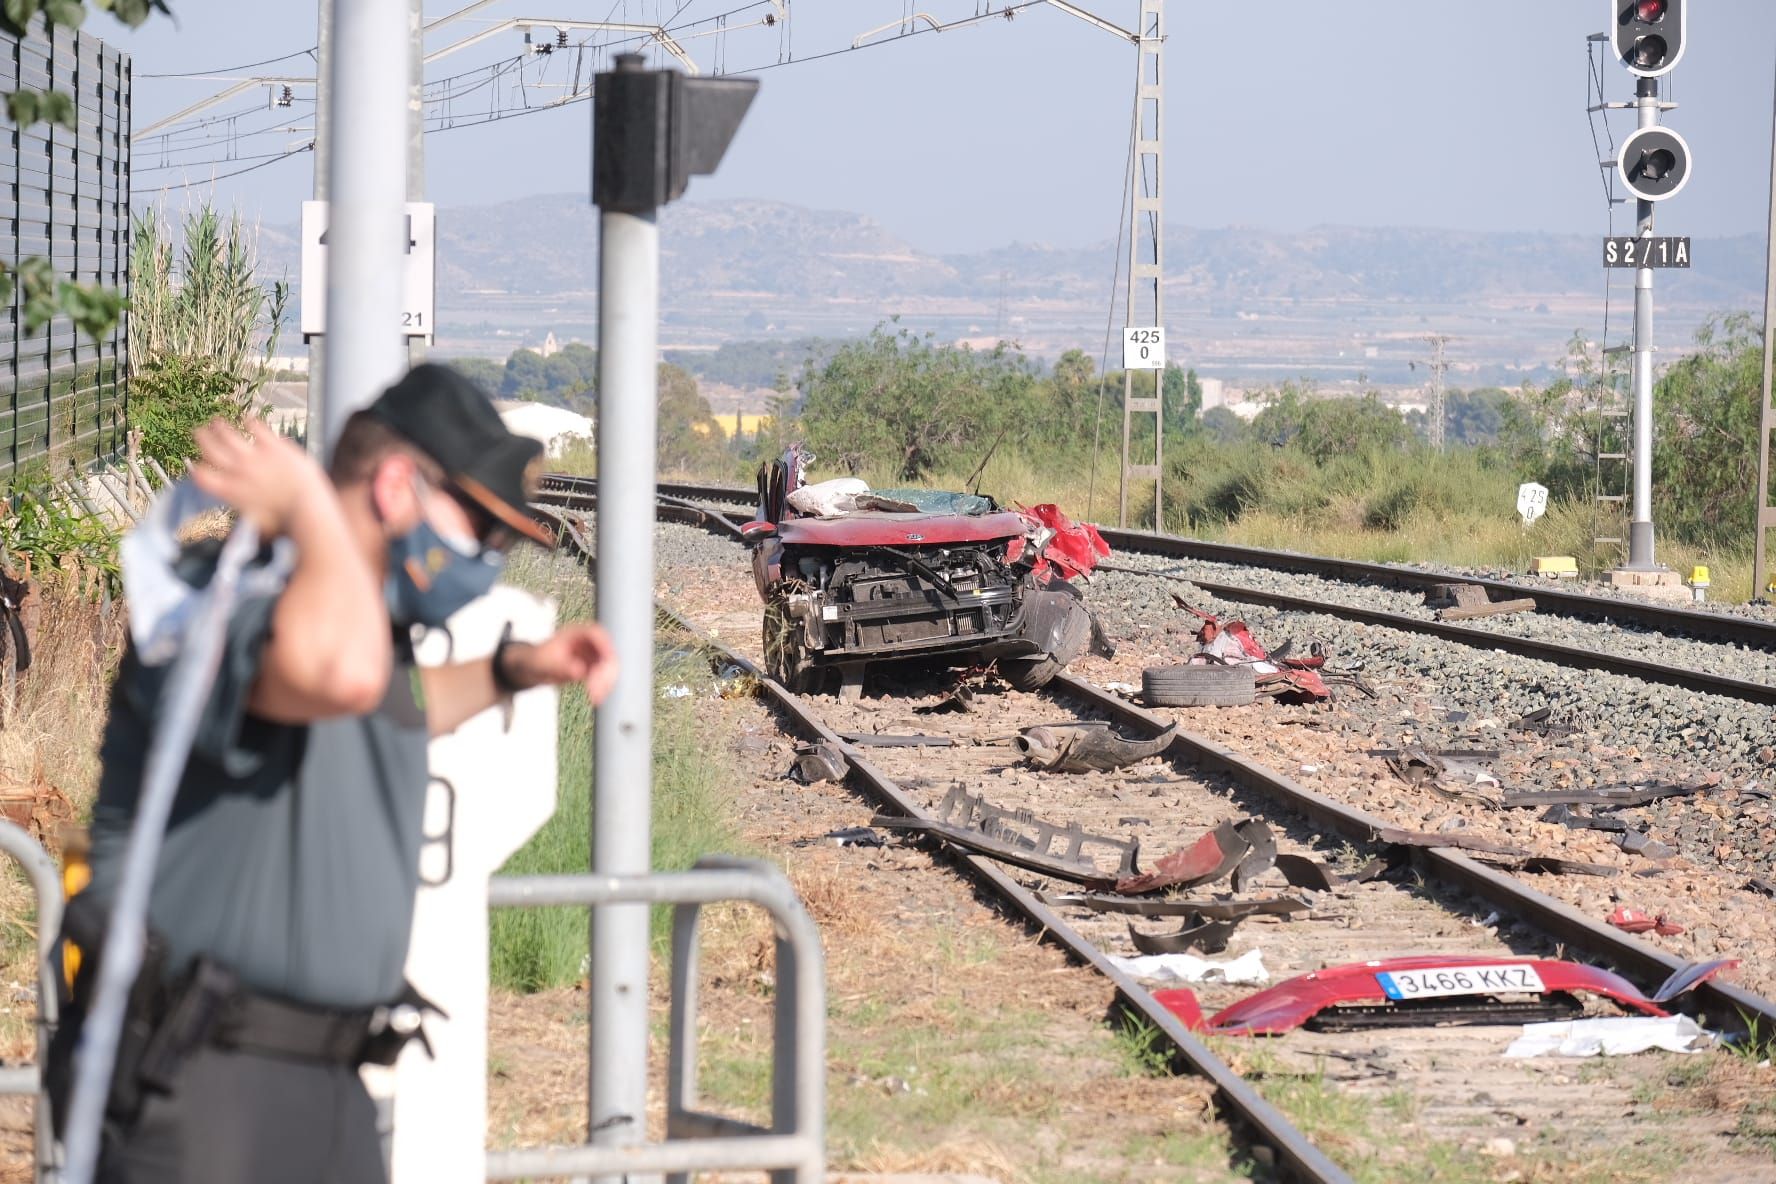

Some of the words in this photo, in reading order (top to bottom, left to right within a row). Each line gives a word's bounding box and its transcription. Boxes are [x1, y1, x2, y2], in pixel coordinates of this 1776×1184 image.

[1130, 330, 1160, 344] 425
[1140, 346, 1149, 360] 0
[1521, 488, 1545, 504] 425
[1400, 972, 1474, 994] 3466
[1477, 969, 1536, 988] KKZ
